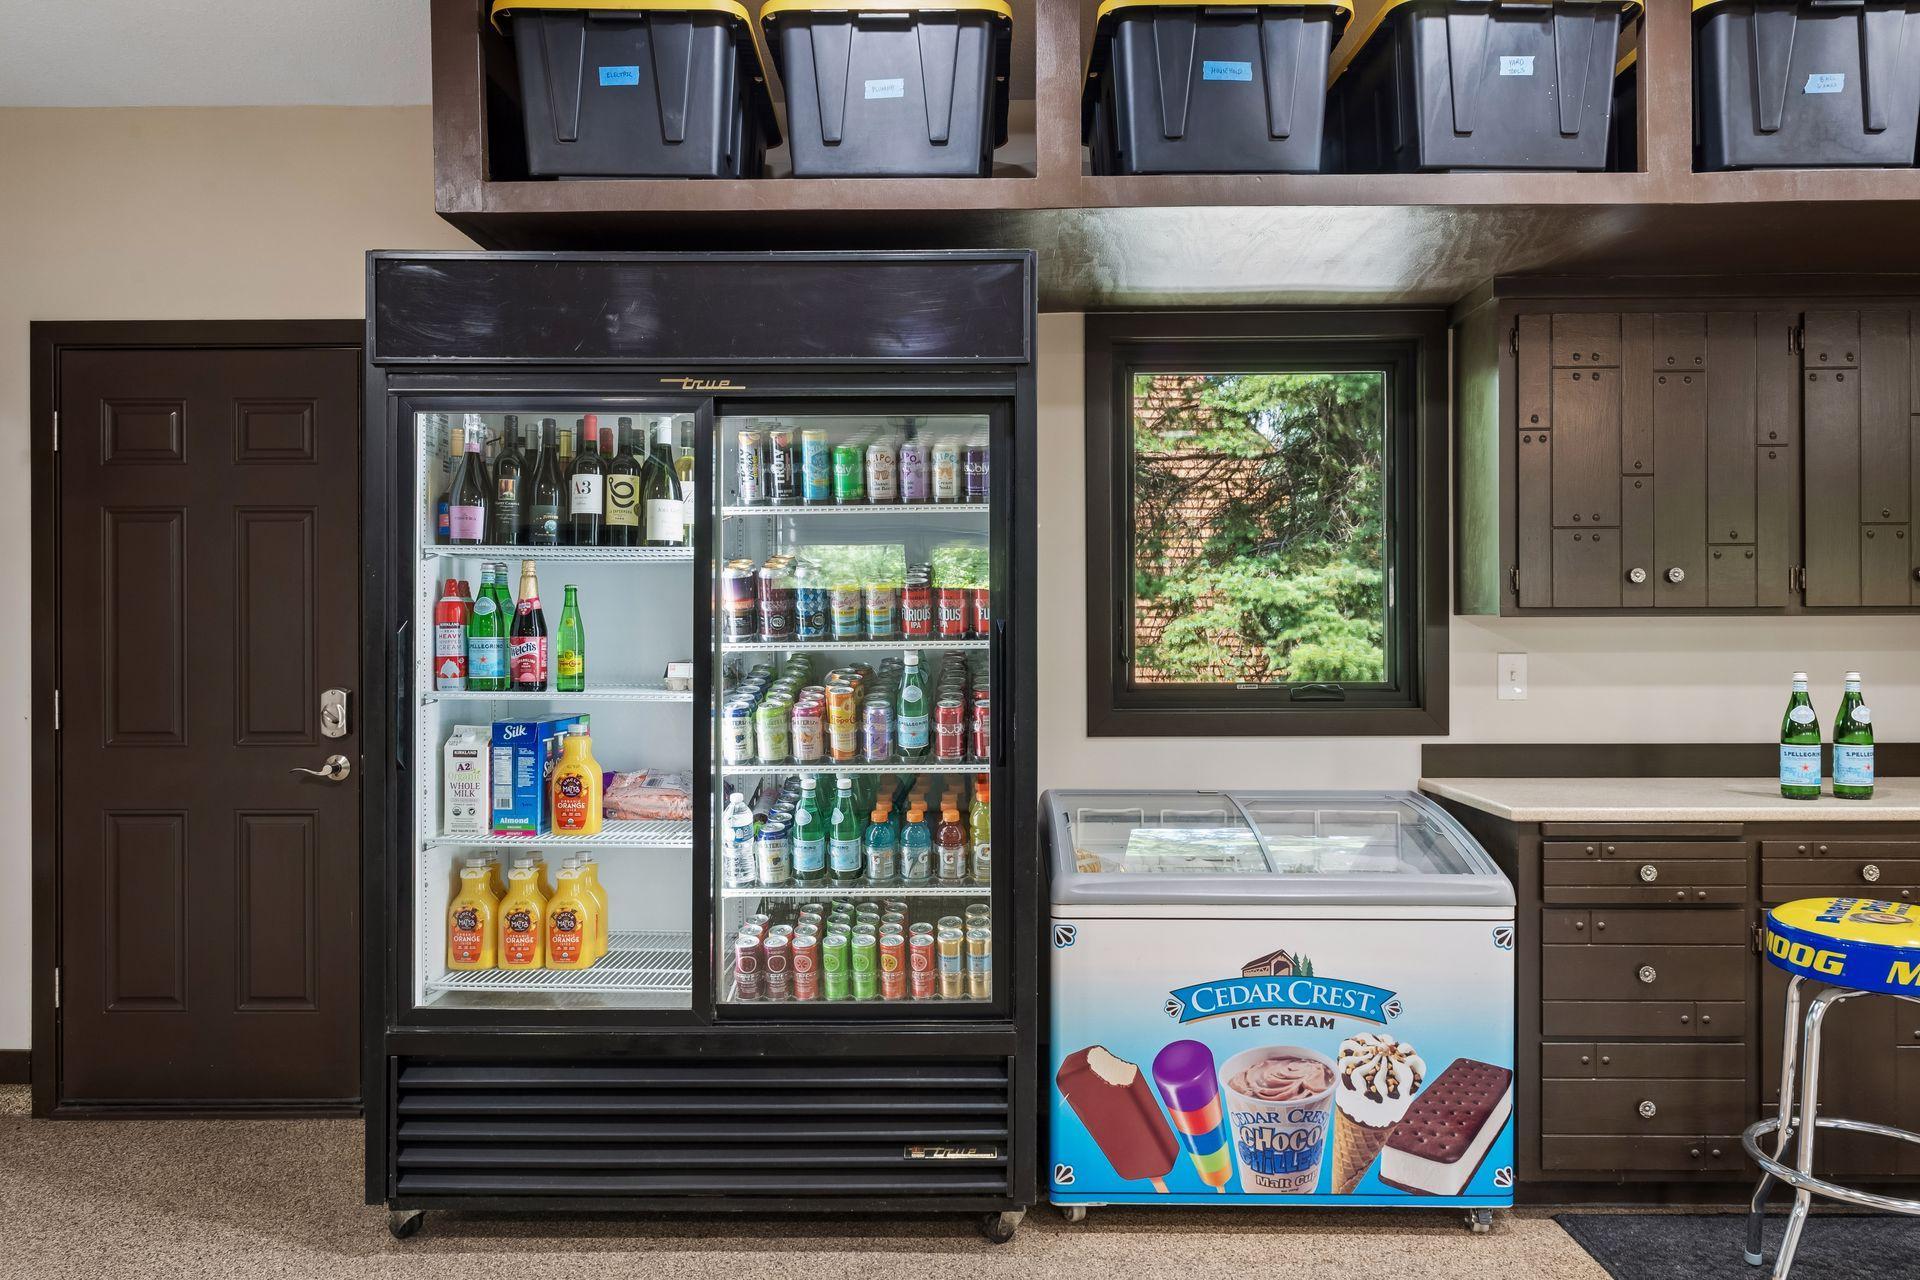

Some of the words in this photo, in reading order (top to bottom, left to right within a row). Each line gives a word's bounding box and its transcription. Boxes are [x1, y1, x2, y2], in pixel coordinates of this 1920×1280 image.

[775, 450, 785, 484] TRULY
[503, 724, 528, 740] Silk
[457, 762, 471, 772] A2
[450, 782, 481, 790] WHOLE
[453, 789, 476, 798] MILK
[500, 817, 529, 825] Almond
[506, 936, 534, 944] ORANGE
[1191, 982, 1283, 1013] CEDAR
[1288, 980, 1376, 1014] CREST
[1231, 1015, 1261, 1030] ICE
[1267, 1014, 1336, 1030] CREAM
[1240, 1125, 1322, 1152] CHOCO
[1255, 1174, 1292, 1189] Malt
